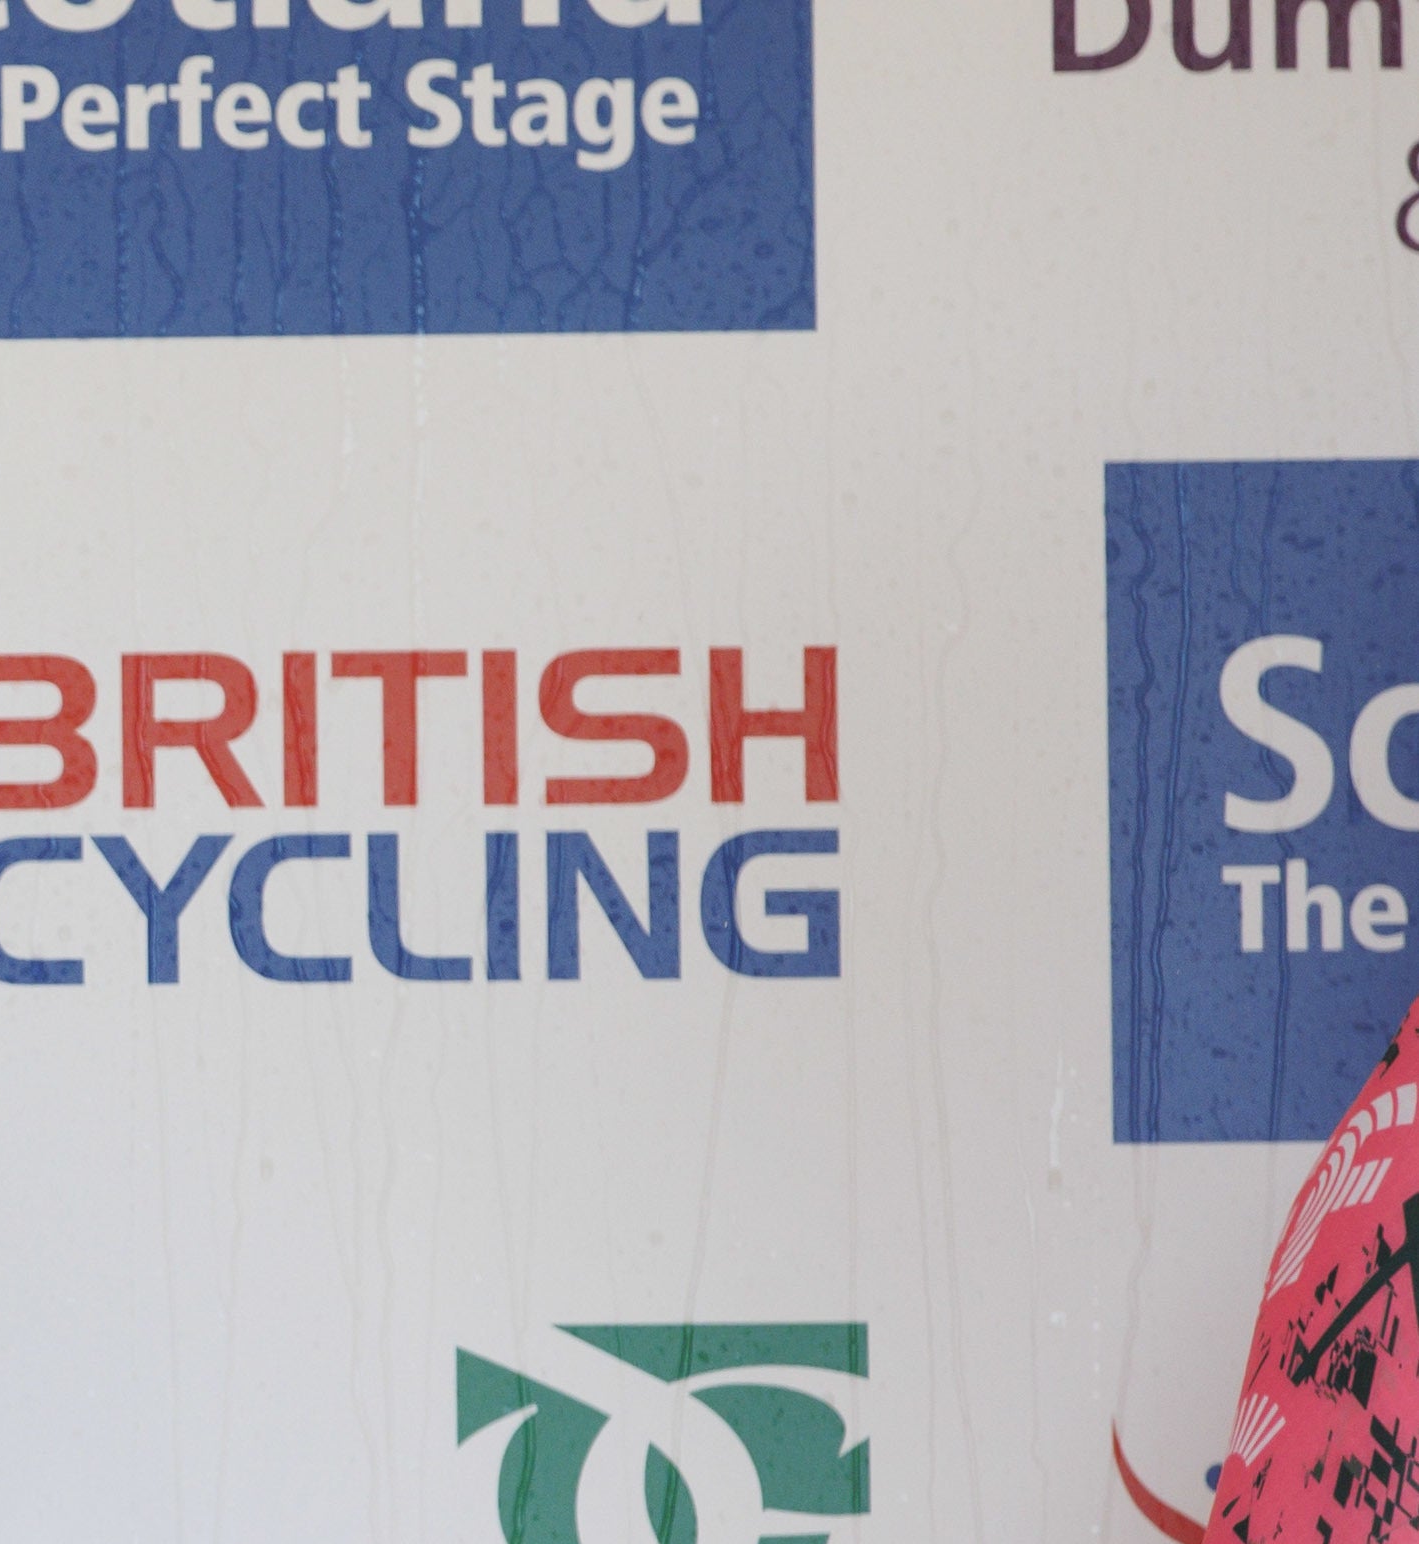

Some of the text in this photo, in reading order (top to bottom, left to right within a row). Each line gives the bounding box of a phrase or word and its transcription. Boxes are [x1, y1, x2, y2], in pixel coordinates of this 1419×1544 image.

[0, 56, 372, 153] Perfect
[406, 59, 699, 170] Stage
[1222, 859, 1409, 953] The
